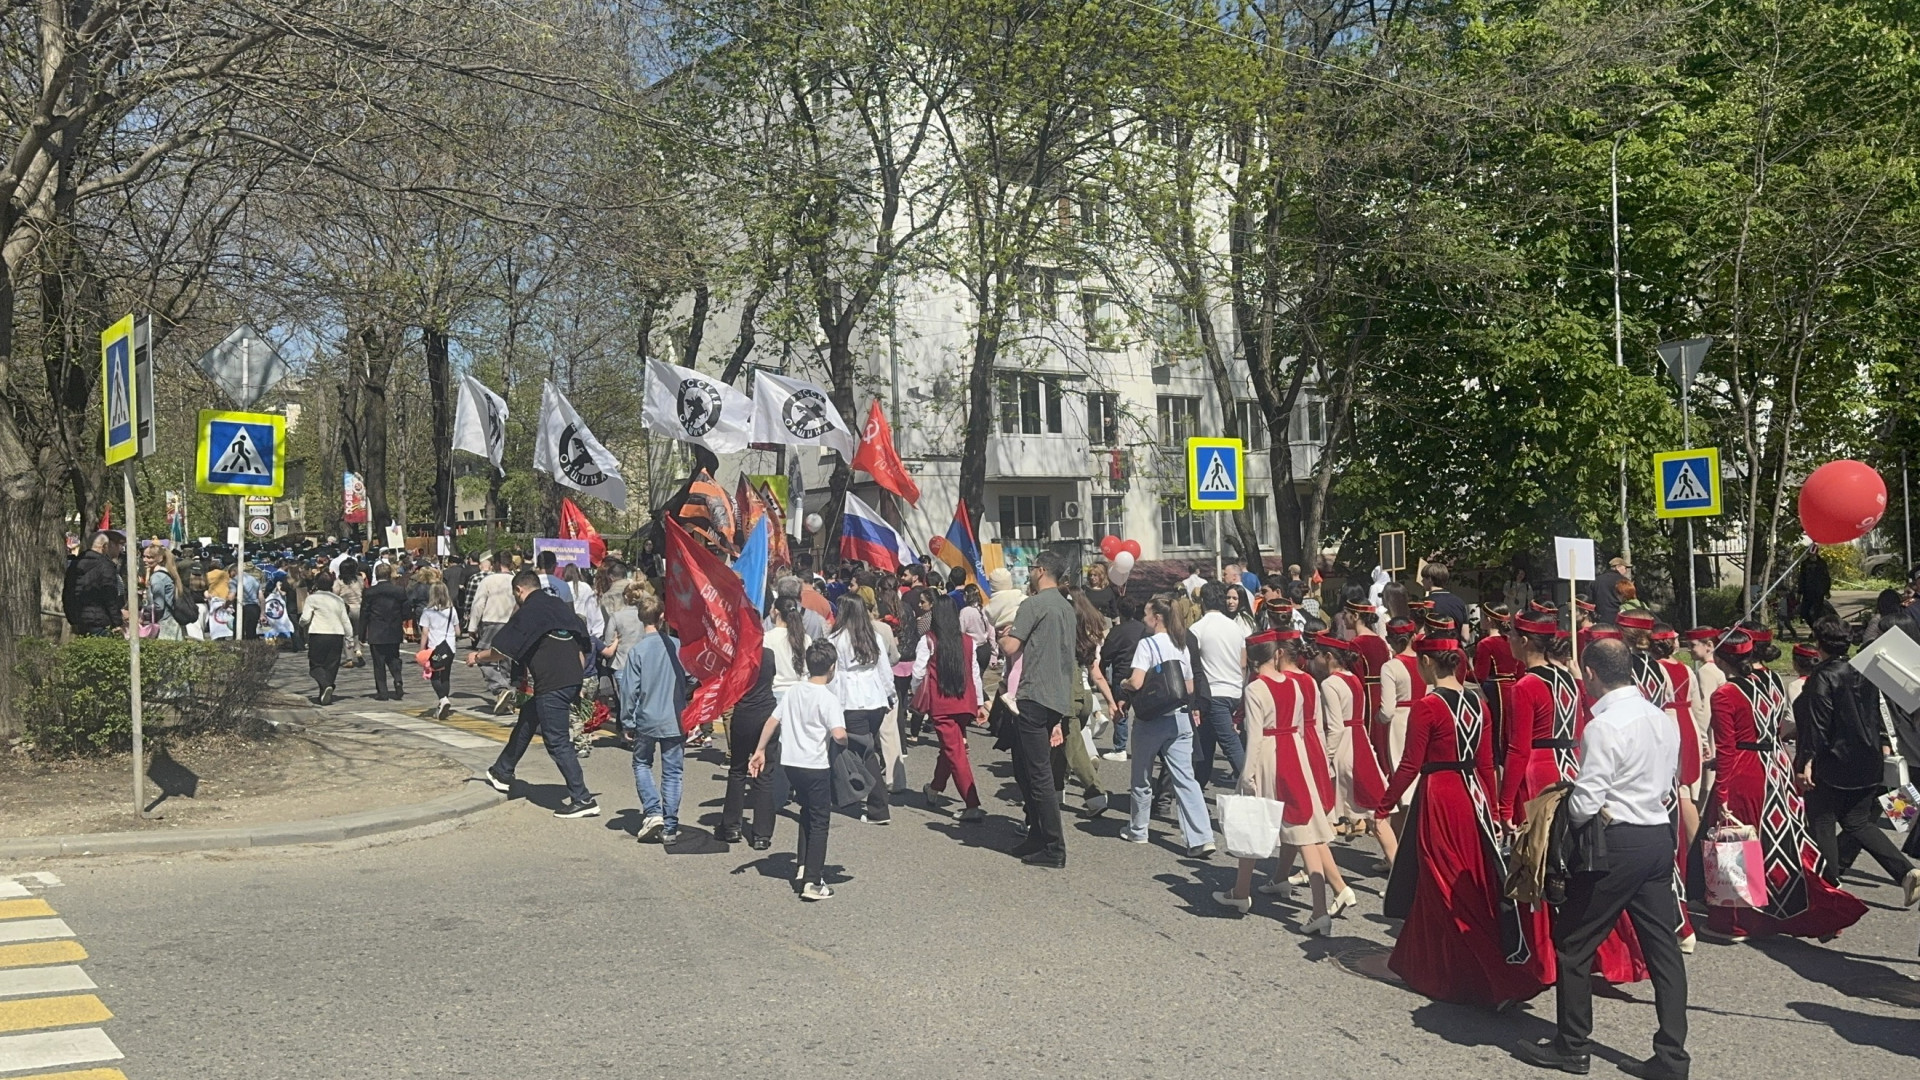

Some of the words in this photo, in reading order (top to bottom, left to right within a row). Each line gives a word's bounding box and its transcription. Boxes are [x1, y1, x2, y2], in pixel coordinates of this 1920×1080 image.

[785, 418, 830, 438] ОБЩИНА
[254, 522, 267, 531] 40
[700, 583, 718, 602] 150
